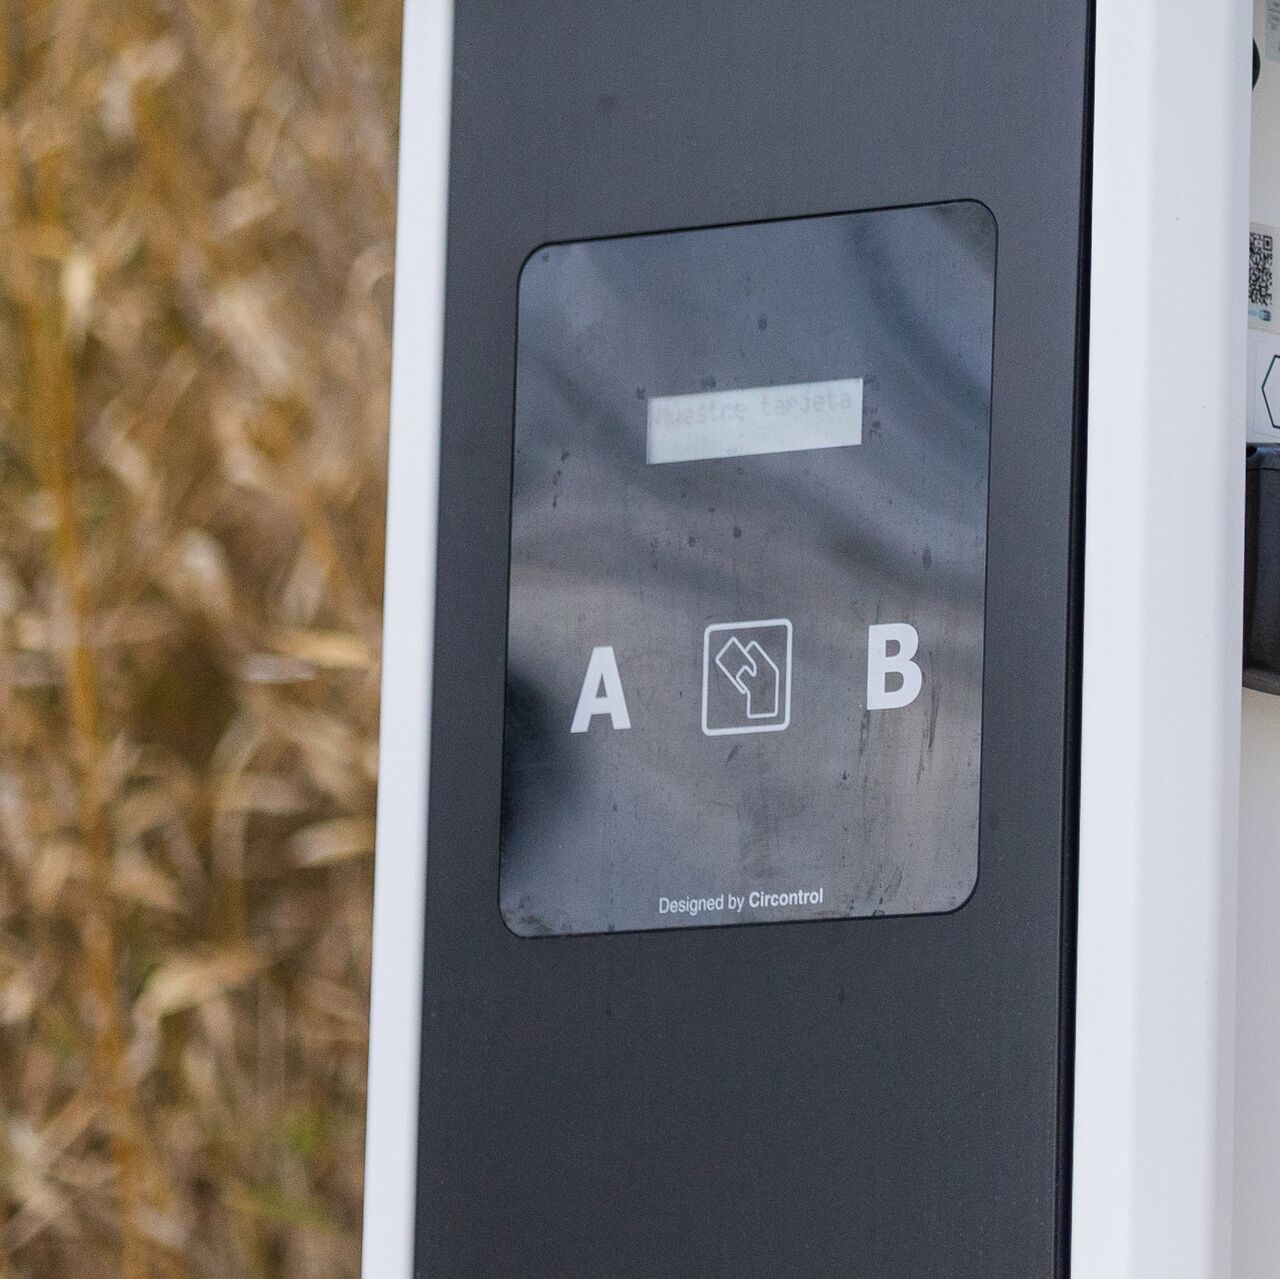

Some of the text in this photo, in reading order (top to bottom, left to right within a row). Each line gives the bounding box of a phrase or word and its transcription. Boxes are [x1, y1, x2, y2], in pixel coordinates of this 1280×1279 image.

[570, 645, 632, 734] A
[866, 622, 923, 711] B
[658, 887, 824, 916] Designed by Circontrol
